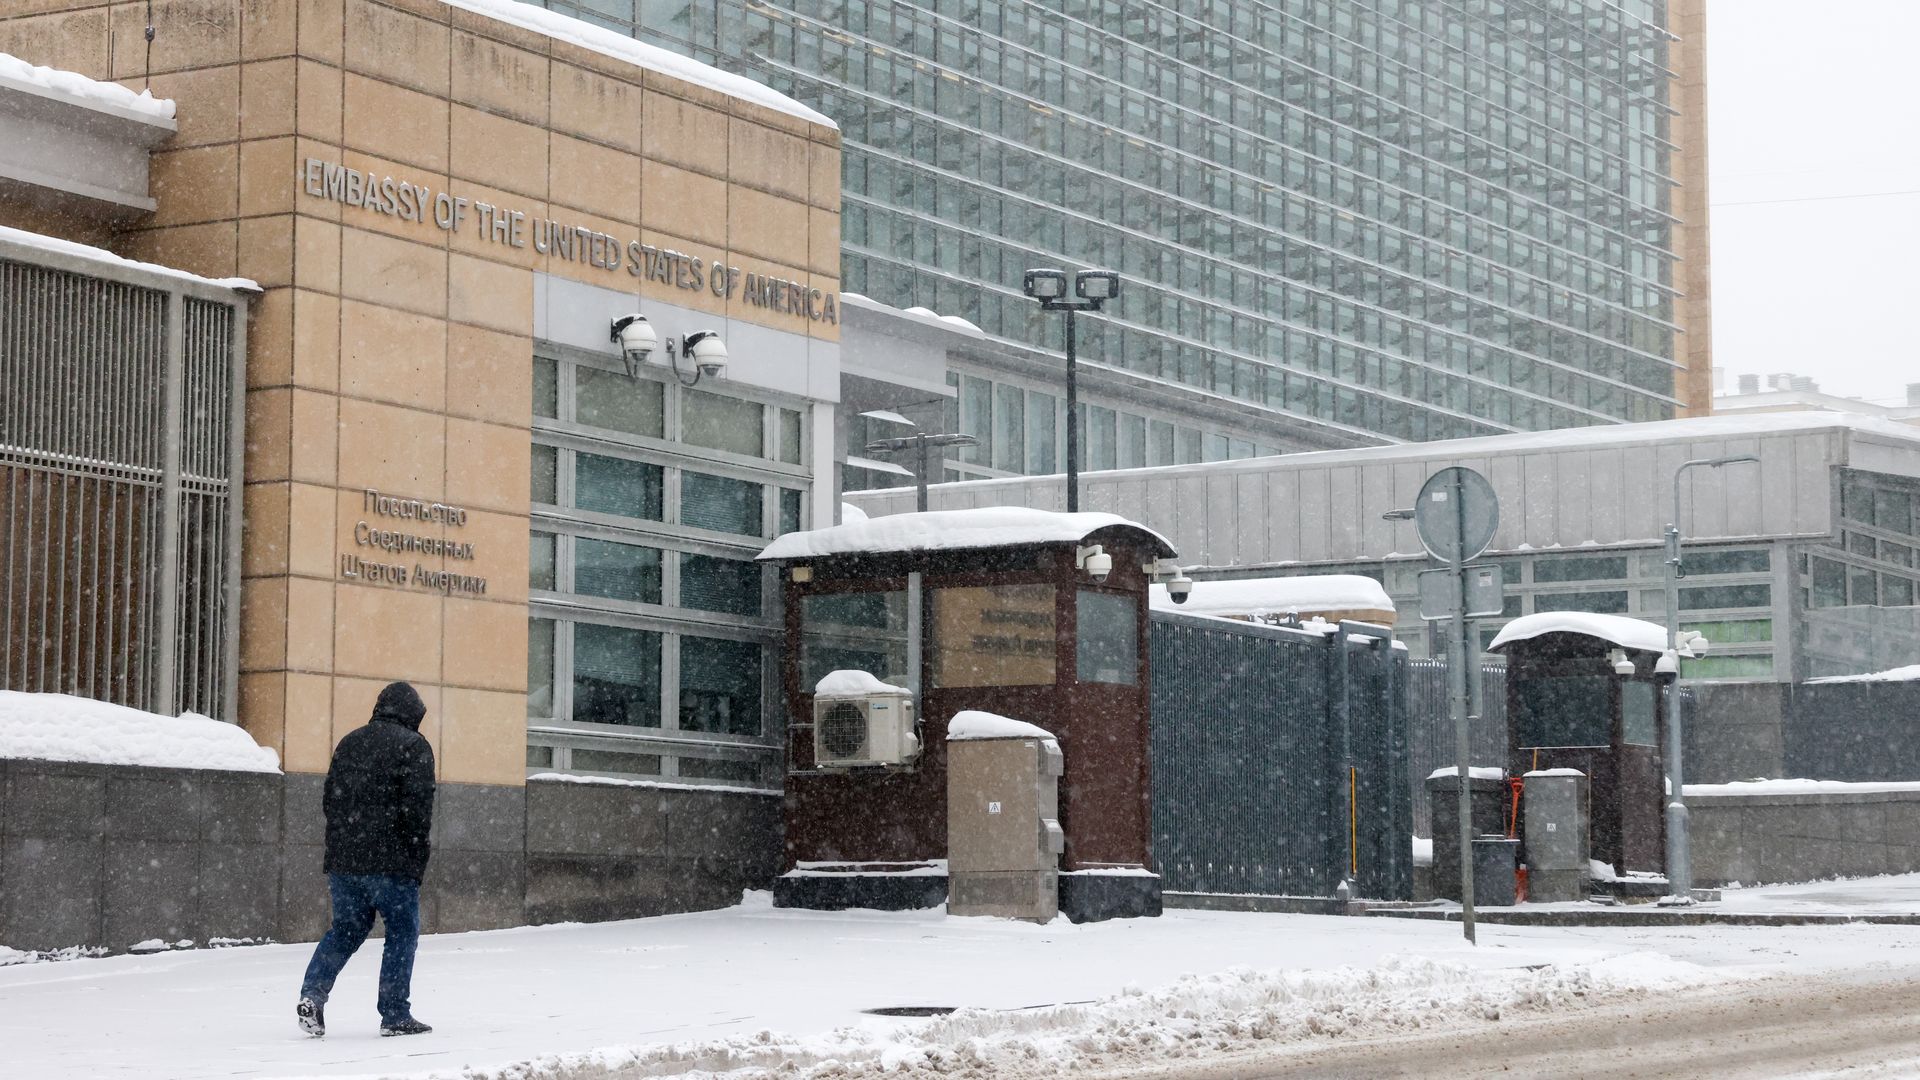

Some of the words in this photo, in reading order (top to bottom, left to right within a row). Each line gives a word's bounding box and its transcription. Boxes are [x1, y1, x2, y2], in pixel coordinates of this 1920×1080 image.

[305, 158, 429, 223] EMBASSY
[434, 192, 467, 233] OF
[475, 200, 524, 248] THE
[533, 217, 621, 271] UNITED
[627, 240, 704, 291] STATES
[710, 261, 740, 299] OF
[743, 272, 837, 324] AMERICA
[363, 488, 466, 526] Посольство
[355, 521, 475, 560] Соединенных
[341, 553, 406, 584] Штатов
[411, 564, 486, 597] Америки
